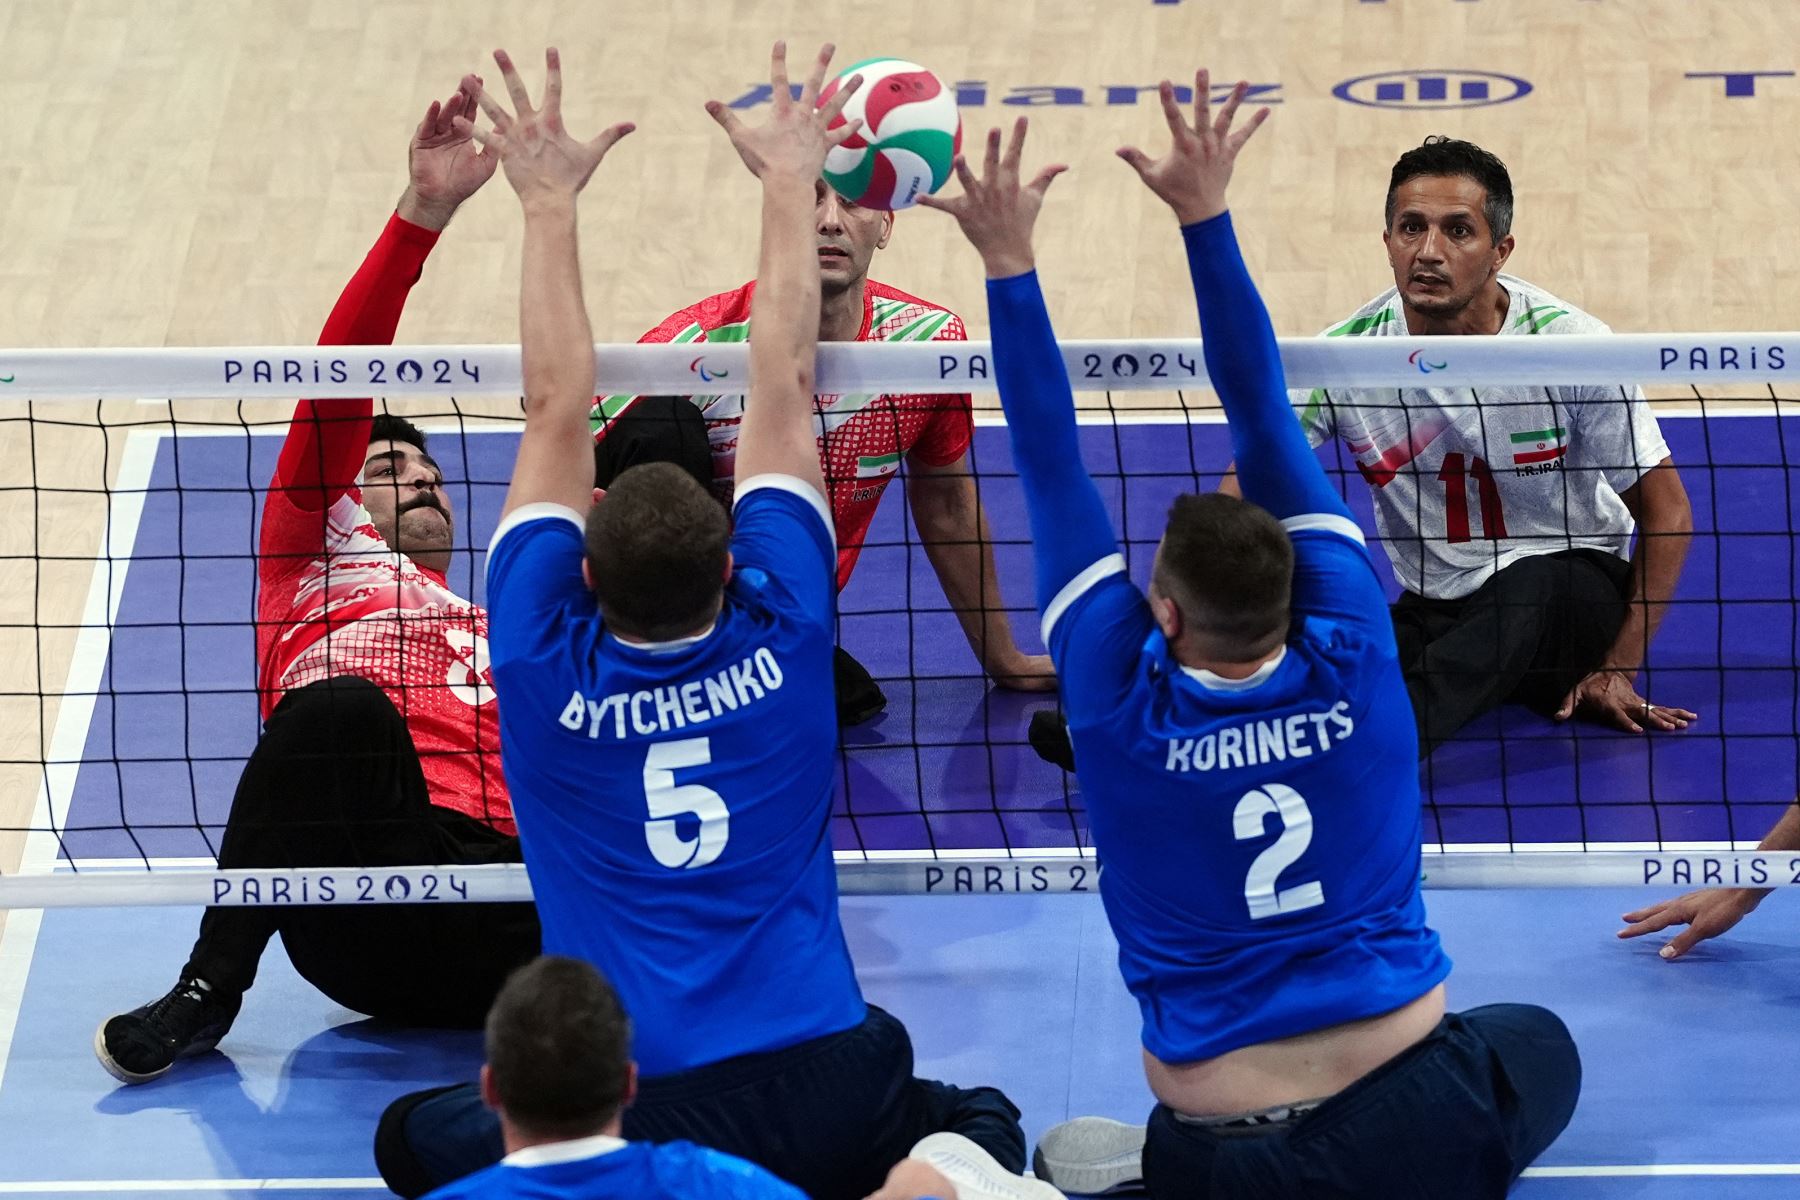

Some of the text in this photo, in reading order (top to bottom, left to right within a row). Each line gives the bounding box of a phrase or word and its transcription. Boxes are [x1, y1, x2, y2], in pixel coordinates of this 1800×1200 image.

[1437, 452, 1509, 544] 11
[558, 646, 784, 739] BYTCHENKO
[1165, 700, 1354, 772] KORINETS
[643, 736, 731, 869] 5
[1232, 782, 1326, 920] 2
